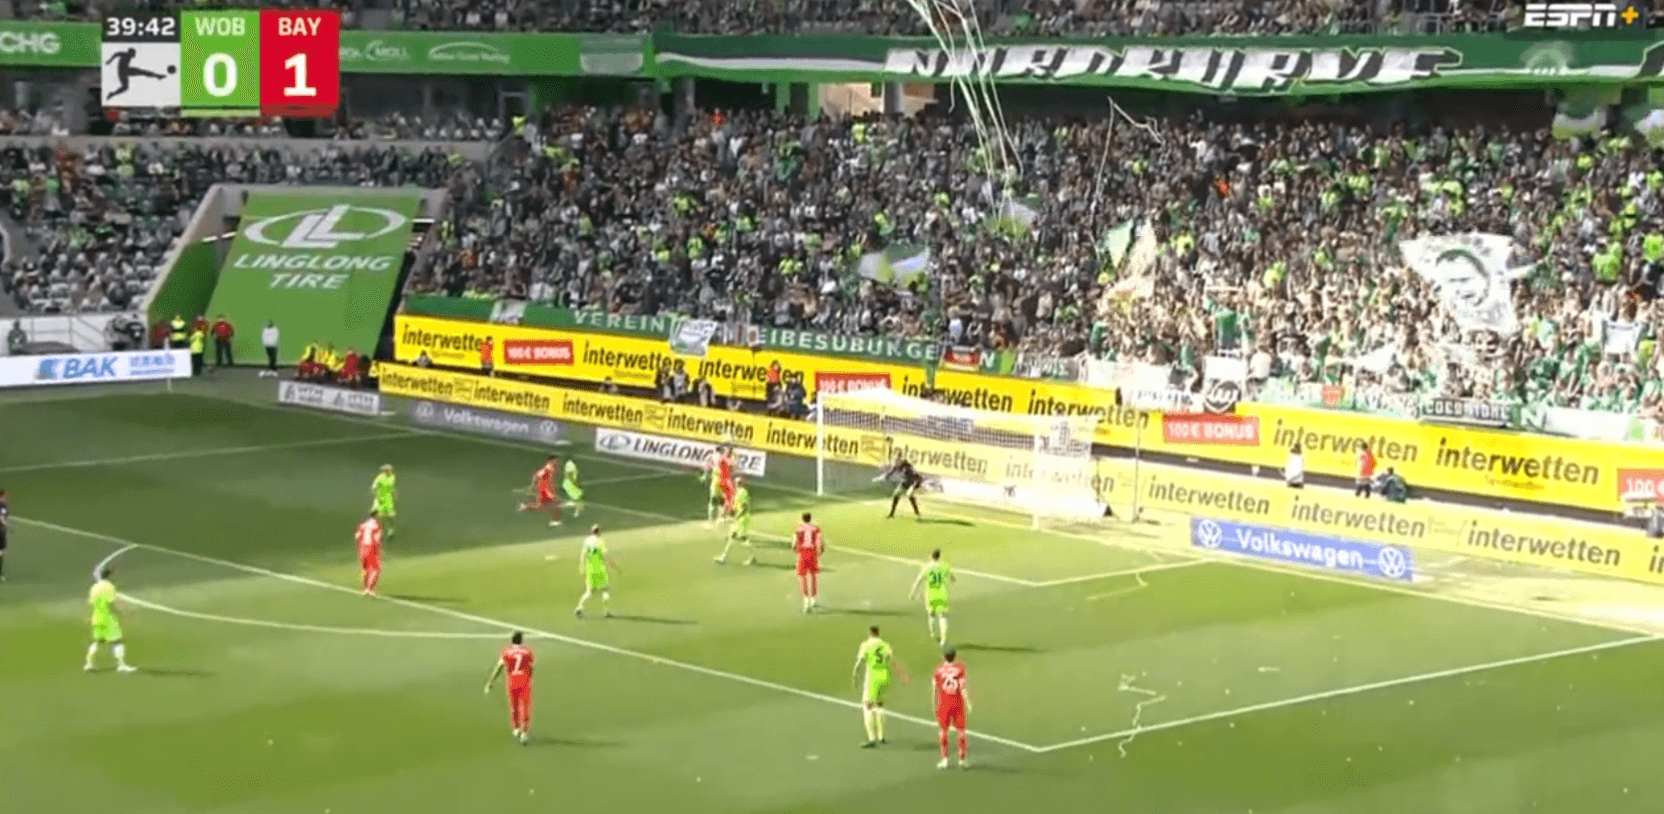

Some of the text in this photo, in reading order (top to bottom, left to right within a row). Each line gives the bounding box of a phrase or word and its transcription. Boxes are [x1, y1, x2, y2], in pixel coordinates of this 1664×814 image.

[233, 253, 395, 271] LINGLONG
[268, 273, 350, 289] TIRE
[574, 310, 665, 332] VEREIN
[63, 356, 118, 379] BAK
[402, 323, 484, 351] interwette
[698, 358, 804, 386] interween
[1204, 422, 1256, 439] BONUS
[1274, 419, 1418, 462] interwetten
[1436, 436, 1599, 485] interwetten
[443, 408, 529, 435] Volkswagen
[382, 367, 453, 394] interwetten
[474, 380, 550, 408] interwetten
[563, 393, 643, 422] interwetten
[668, 408, 754, 439] interwetten
[1148, 475, 1270, 515] interwetten
[1291, 495, 1425, 538] interwetten
[1467, 520, 1621, 567] interwetten
[1235, 528, 1364, 568] Volkswagen
